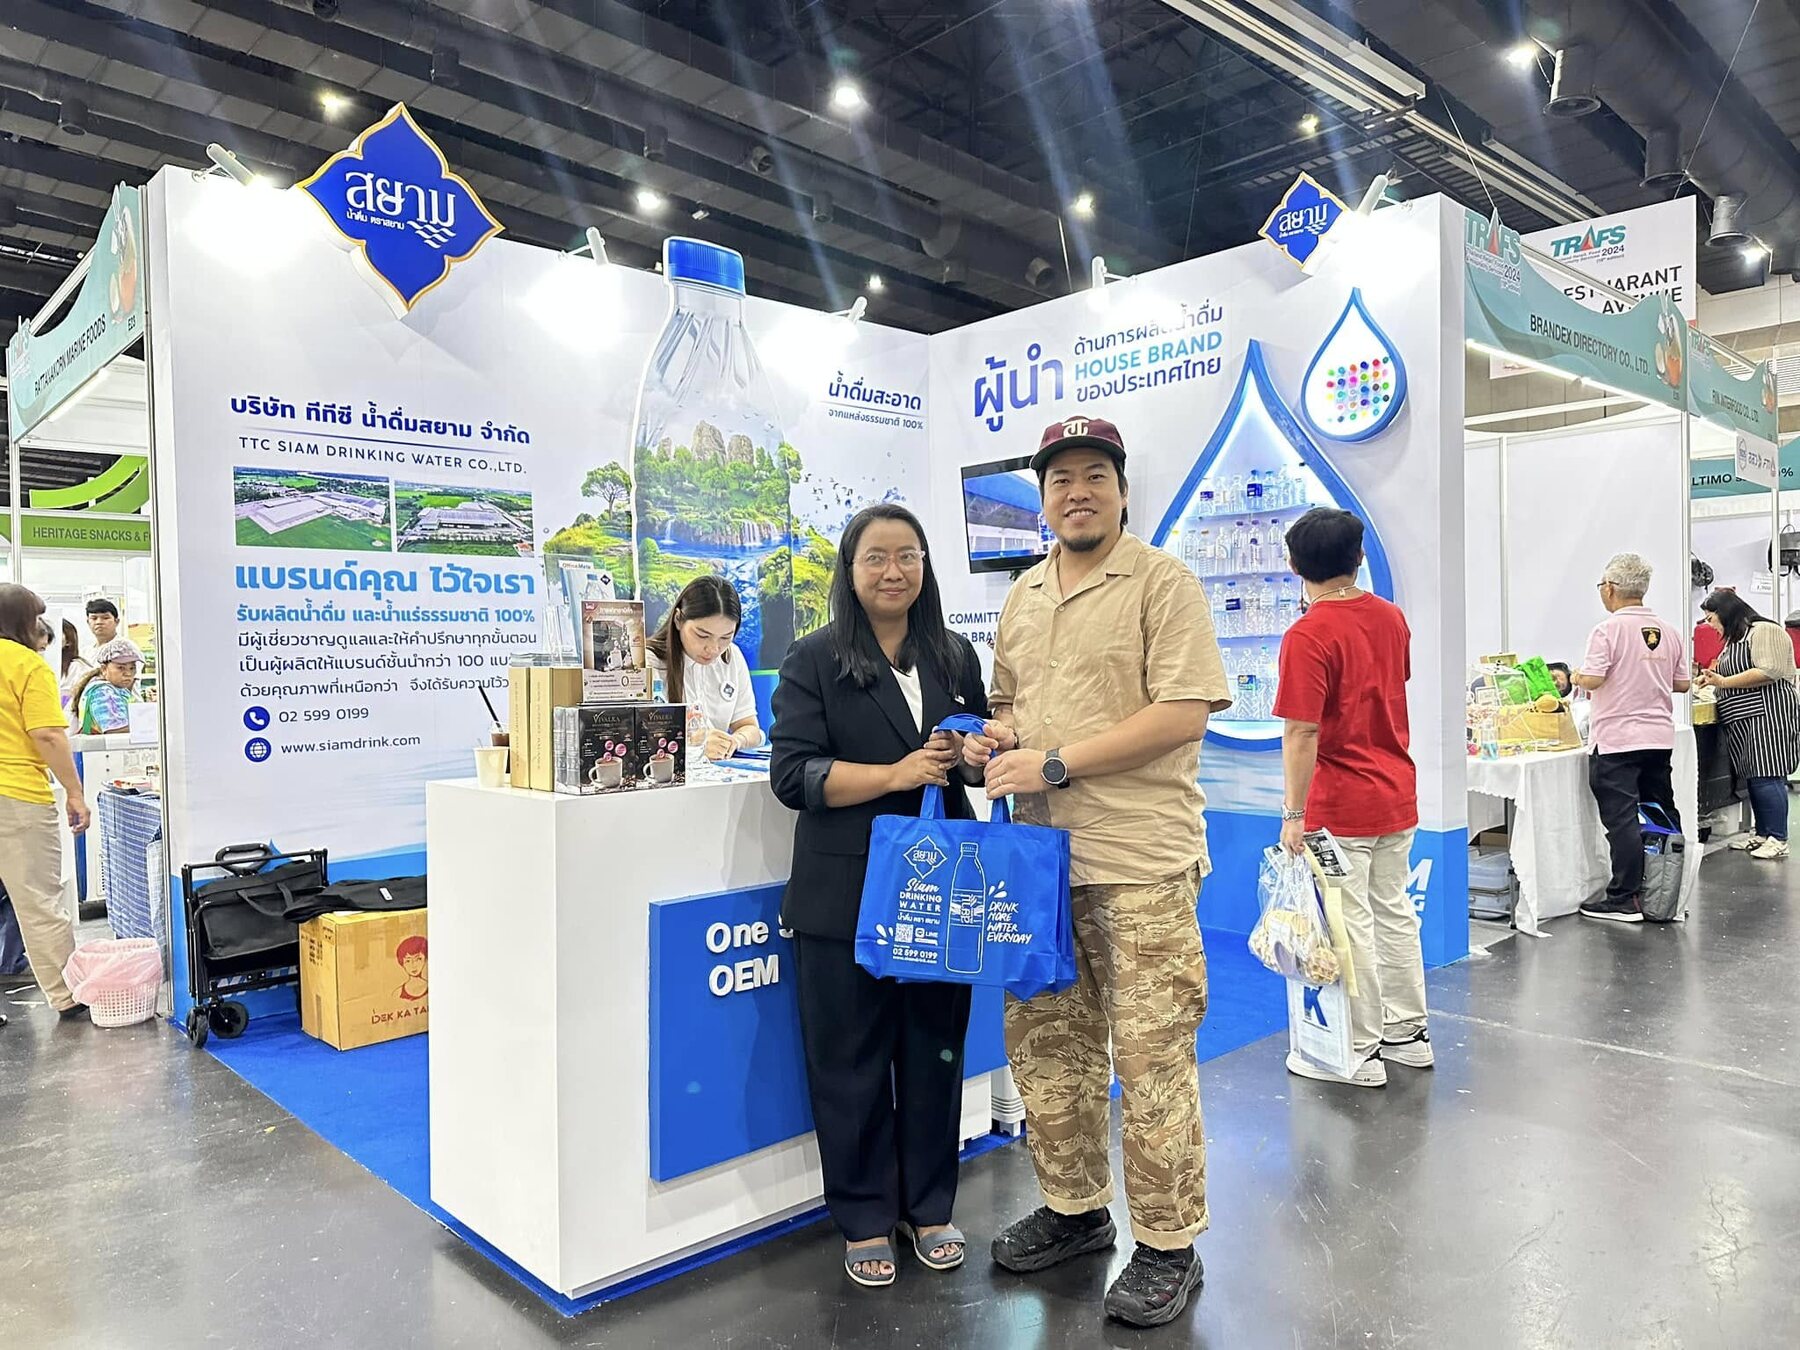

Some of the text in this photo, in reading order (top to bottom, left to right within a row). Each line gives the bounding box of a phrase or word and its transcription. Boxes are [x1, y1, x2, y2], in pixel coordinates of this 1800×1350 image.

[345, 171, 456, 228] สยาม
[1279, 203, 1328, 232] สยาม
[1551, 225, 1626, 257] TRAFS
[1602, 245, 1625, 256] 2024
[1504, 264, 1521, 282] 2024
[86, 313, 106, 347] FOODS
[1075, 331, 1223, 381] HOUSE BRAND
[1530, 314, 1650, 376] BRANDEX DIRECTORY CO., LTD.
[829, 370, 921, 410] น้ำดื่มสะอาด
[975, 343, 1064, 432] ผู้นำ
[1077, 357, 1221, 403] ของประเทศไทย
[231, 395, 530, 444] บริษัท ทีทีซี น้ำดื่มสยาม จำกัด
[828, 409, 924, 430] จากแหล่งธรรมชาติ 100%
[239, 437, 527, 474] TTC SIAM DRINKING WATER CO.,LTD.
[33, 527, 87, 540] HERITAGE
[90, 529, 132, 541] SNACKS
[134, 531, 141, 541] &
[236, 560, 535, 600] แบรนด์คุณ ไว้ใจเรา
[237, 599, 535, 622] รับผลิตน้ำดื่ม และน้ำแร่ธรรมชาติ 100%
[238, 627, 537, 650] มีผู้เชี่ยวชาญดูแลและให้คำปรึกษาทุกขั้นตอน
[240, 653, 451, 676] เป็นผู้ผลิตให้แบรนด์ชั้นนำกว่า
[458, 655, 484, 667] 100
[240, 677, 398, 699] ด้วยคุณภาพที่เหนือกว่า
[279, 708, 370, 723] 02 599 0199
[281, 734, 421, 754] www.siamdrink.com
[905, 877, 940, 893] Siam
[899, 891, 942, 903] DRINKING
[899, 900, 941, 912] WATER
[988, 901, 1019, 913] DRINK
[987, 922, 1018, 932] WATER
[988, 913, 1012, 922] MORE
[706, 921, 769, 954] One
[987, 931, 1032, 945] EVERYDAY
[892, 947, 938, 959] 02 599 0199
[708, 954, 779, 997] OEM
[397, 1010, 411, 1019] KA
